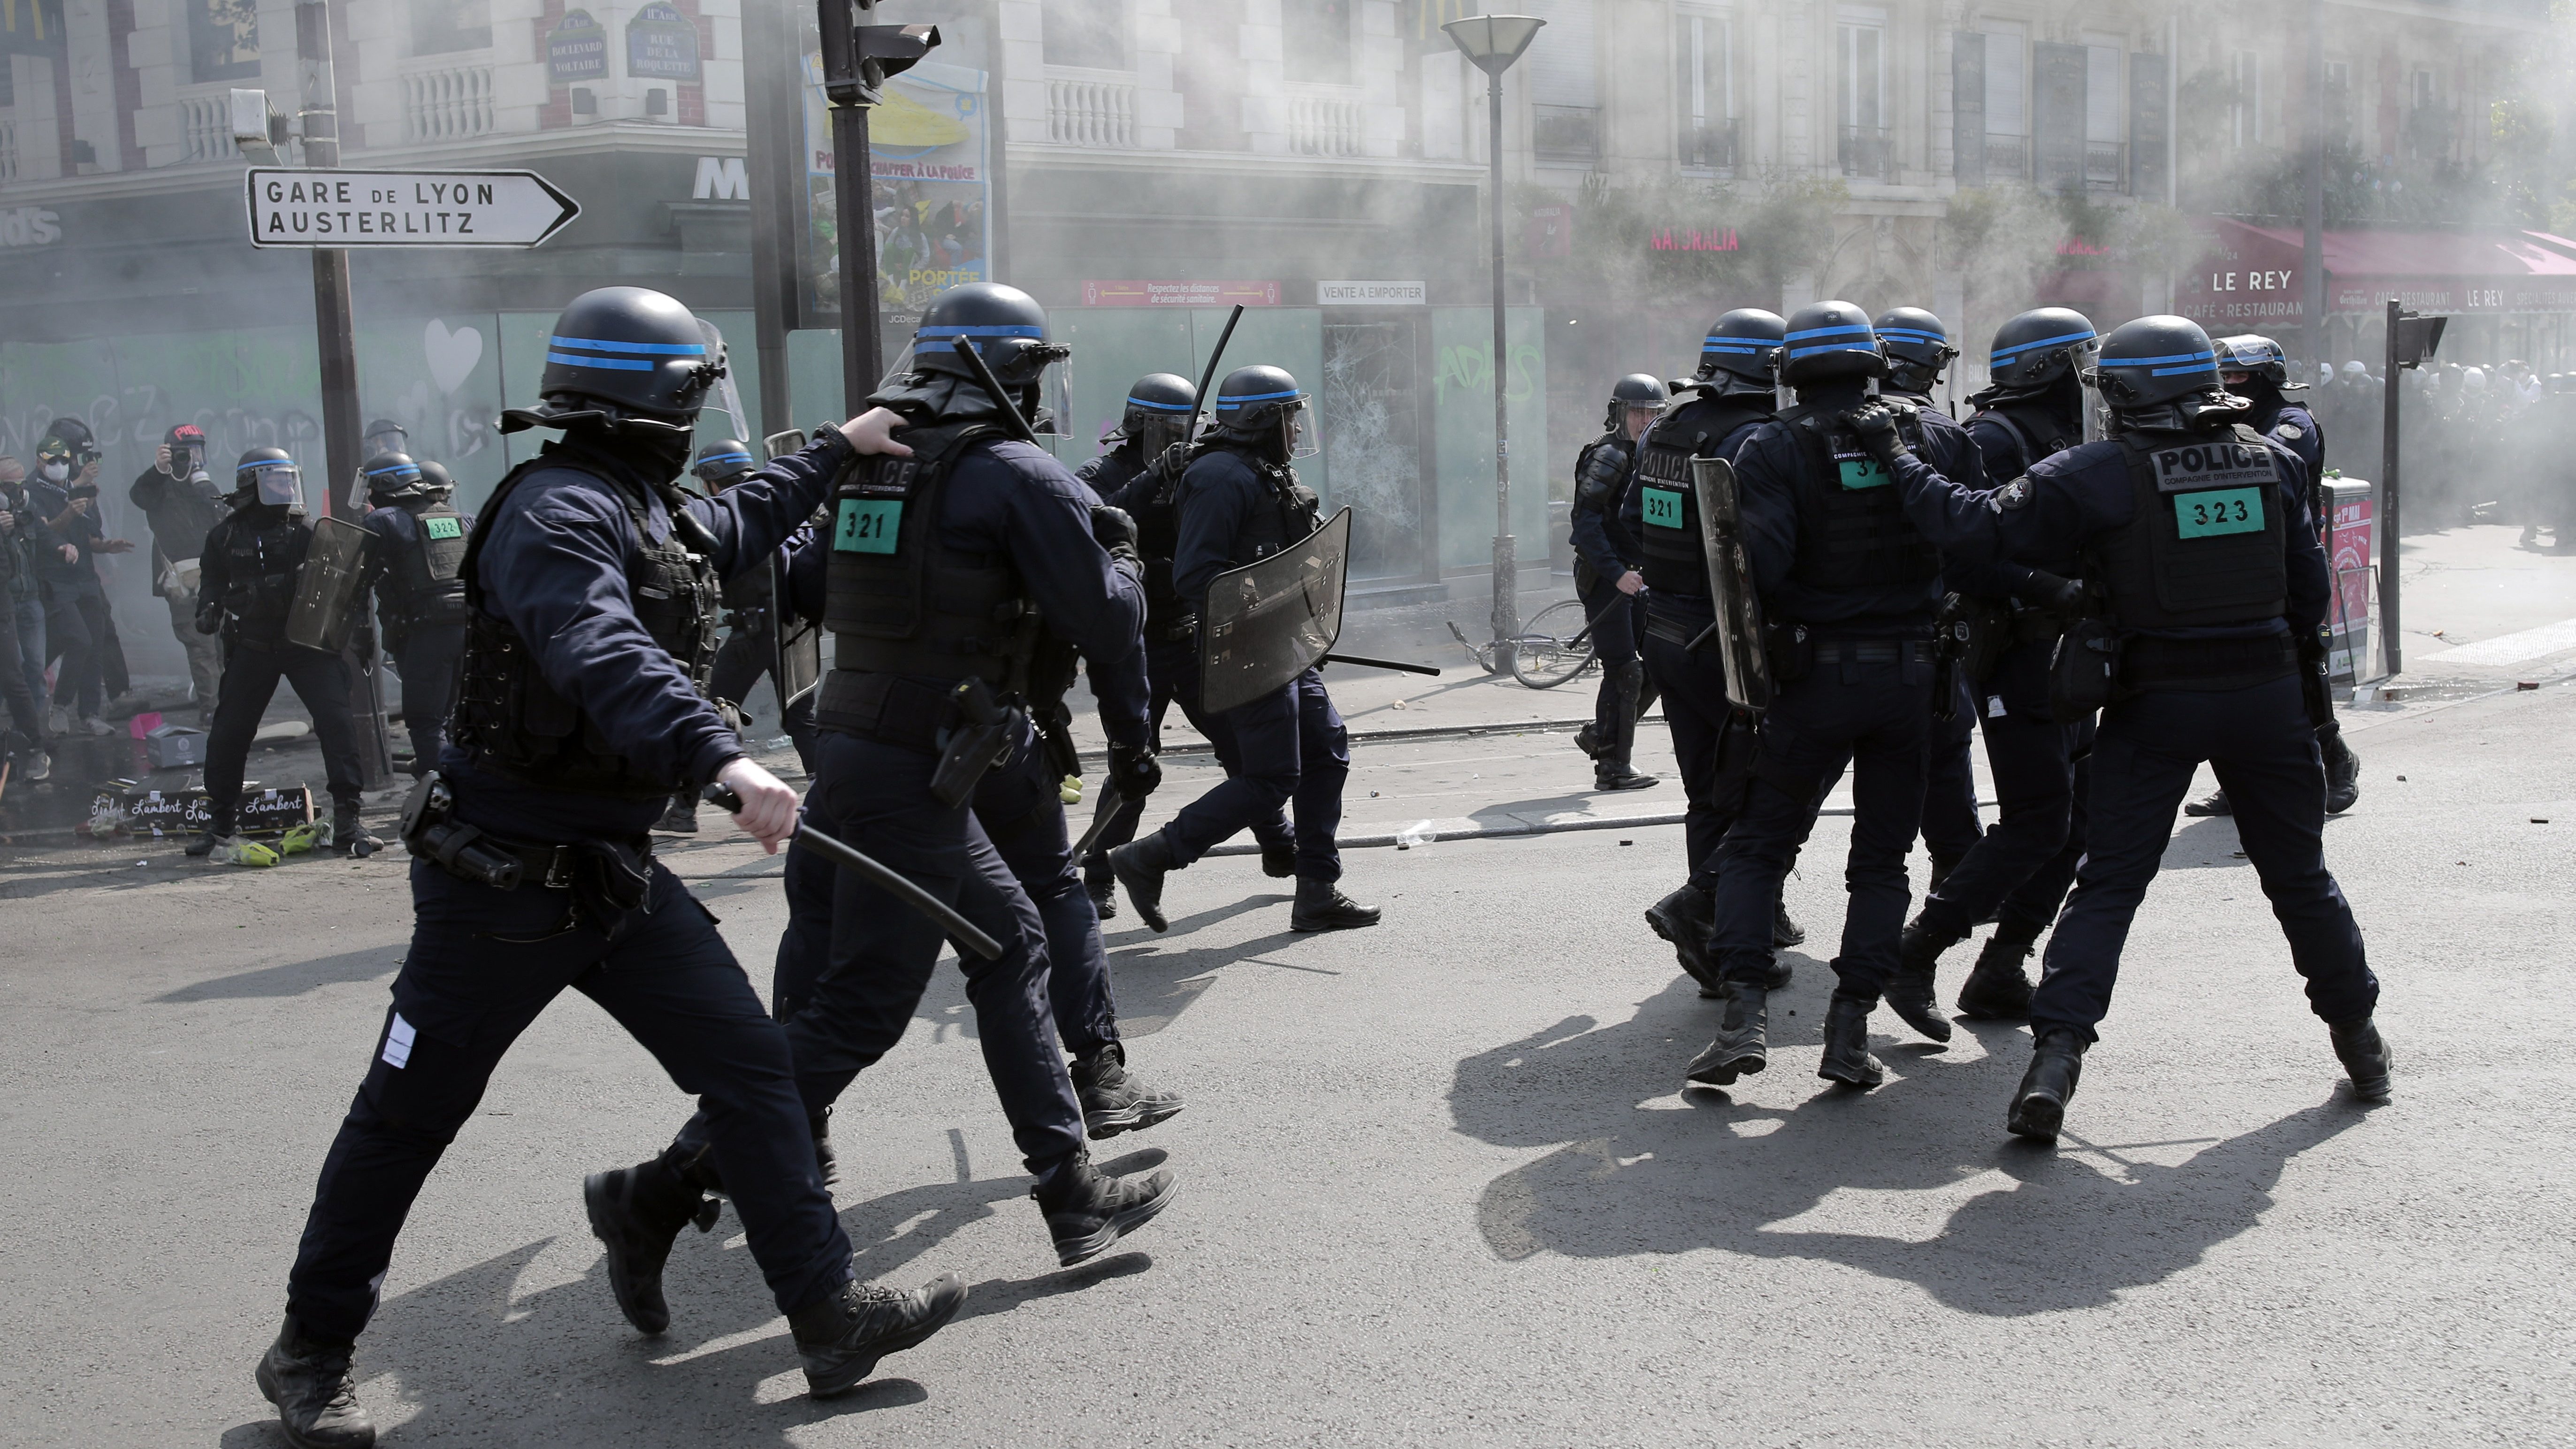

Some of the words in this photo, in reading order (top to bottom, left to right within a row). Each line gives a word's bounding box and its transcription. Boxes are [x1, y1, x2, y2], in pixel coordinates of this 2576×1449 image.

[650, 34, 674, 45] RUE
[552, 41, 603, 56] BOULEVARD
[647, 46, 662, 57] DE
[665, 47, 679, 58] LA
[555, 59, 601, 72] VOLTAIRE
[635, 59, 691, 72] ROQUETTE
[926, 166, 938, 178] LA
[267, 181, 352, 204] GARE
[371, 190, 397, 204] DE
[416, 183, 493, 205] LYON
[1534, 207, 1561, 218] NATURALIA
[268, 212, 474, 233] AUSTERLITZ
[1147, 283, 1179, 294] Respectez
[1180, 283, 1189, 293] les
[1190, 283, 1219, 293] distances
[2213, 272, 2237, 292] LE
[2249, 270, 2292, 290] REY
[1151, 294, 1159, 303] de
[1160, 294, 1185, 303] sécurité
[1186, 294, 1216, 303] sanitaire.
[1324, 287, 1356, 298] VENTE
[1359, 287, 1365, 298] A
[1368, 287, 1421, 298] EMPORTER
[2401, 291, 2450, 306] RESTAURANT
[2468, 290, 2479, 306] LE
[2484, 290, 2503, 306] REY
[2184, 302, 2216, 318] CAFÉ
[2227, 301, 2303, 317] RESTAURAN
[1968, 364, 1983, 382] BIO
[1641, 450, 1690, 481] POLICE
[2158, 445, 2270, 475] POLICE
[2164, 474, 2211, 485] COMPAGNIE
[2214, 470, 2272, 480] D'INTERVENTION
[1649, 497, 1672, 518] 321
[2194, 500, 2248, 525] 323
[435, 522, 455, 533] 322
[846, 512, 884, 538] 321
[132, 797, 182, 816] Lambert
[245, 795, 303, 814] Lambert
